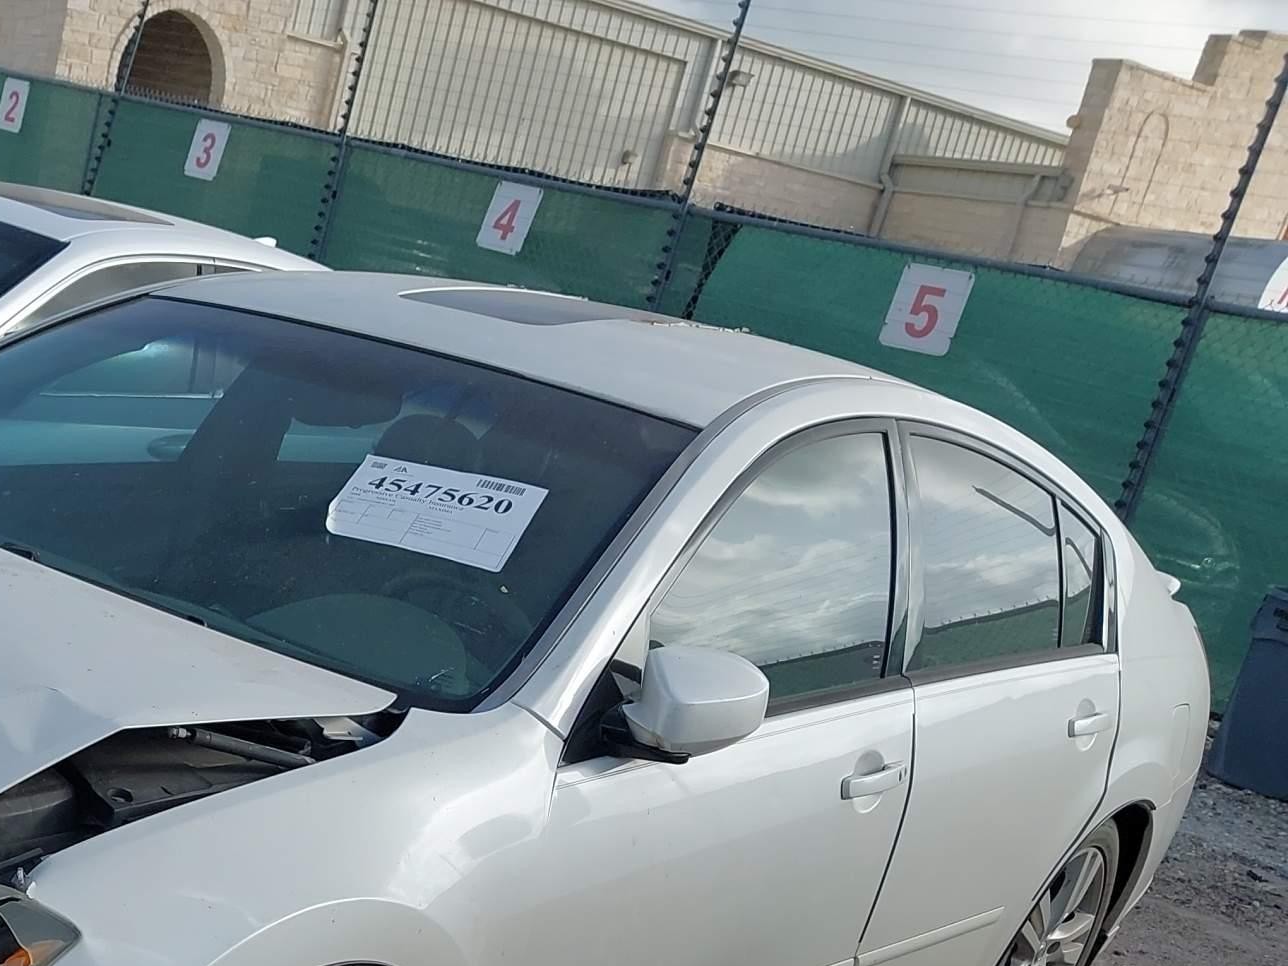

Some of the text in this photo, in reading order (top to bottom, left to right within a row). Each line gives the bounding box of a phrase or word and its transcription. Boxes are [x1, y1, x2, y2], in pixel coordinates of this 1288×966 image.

[4, 91, 19, 122] 2
[196, 132, 216, 168] 3
[493, 199, 521, 240] 4
[904, 284, 947, 338] 5
[368, 476, 513, 515] 45475620
[428, 499, 465, 511] Insurance
